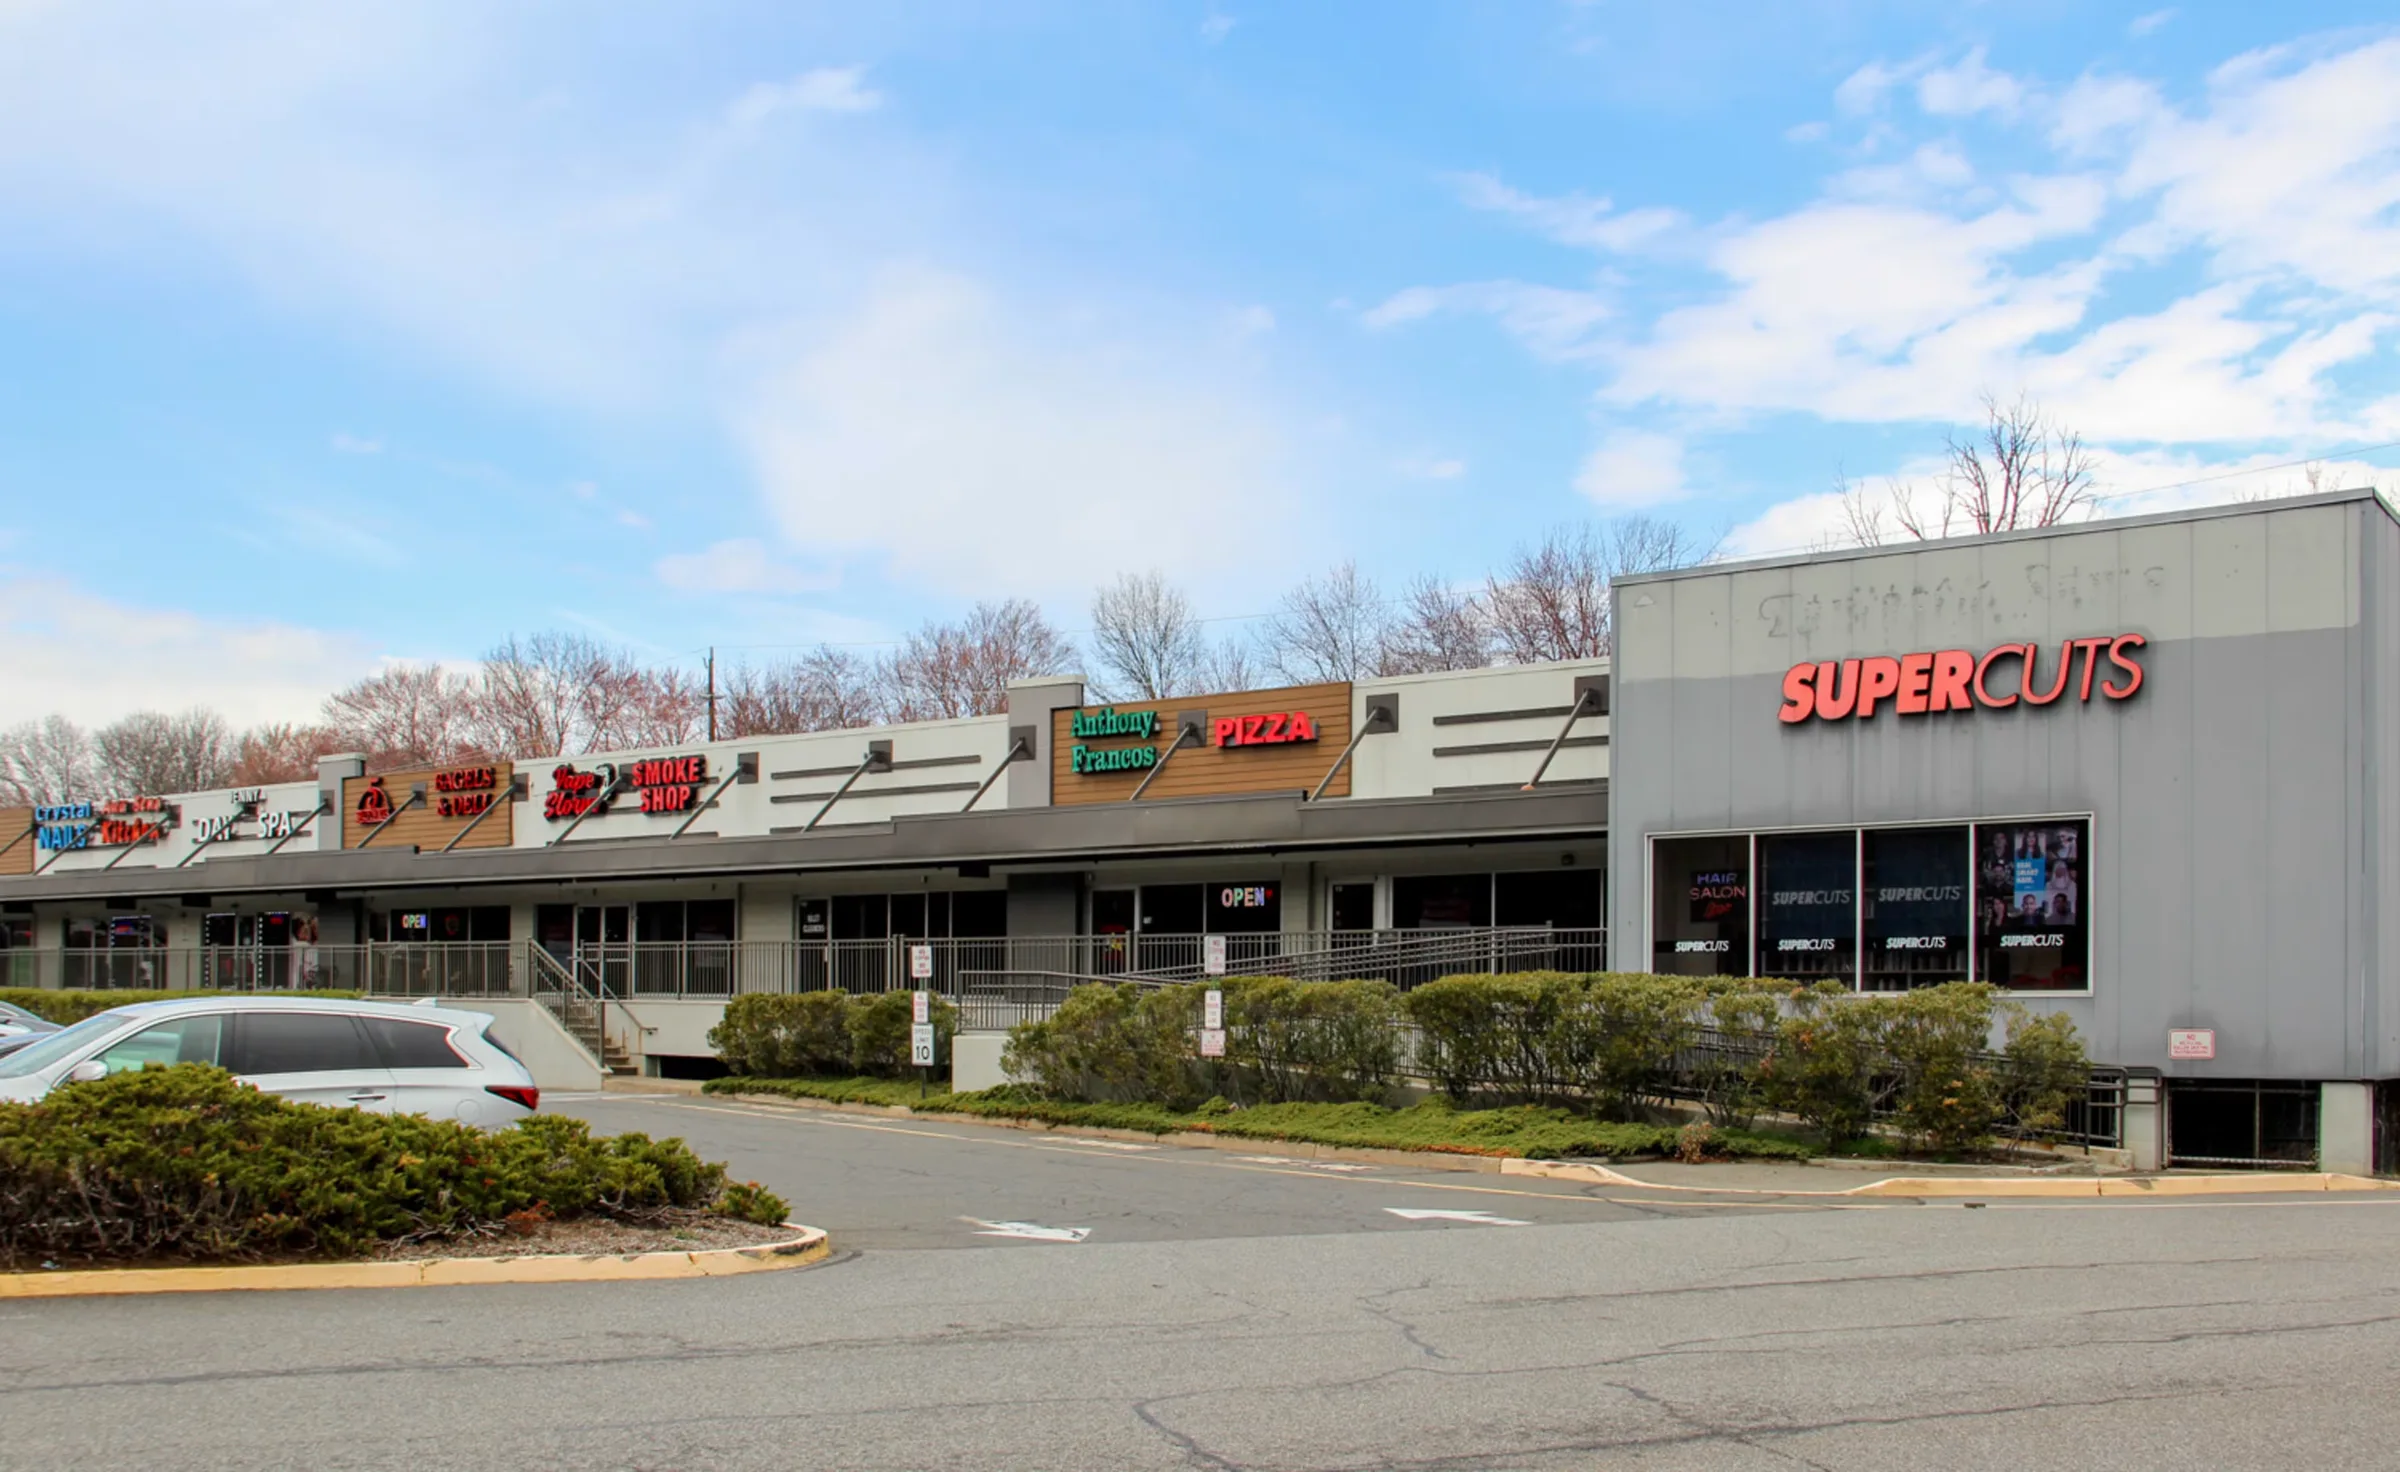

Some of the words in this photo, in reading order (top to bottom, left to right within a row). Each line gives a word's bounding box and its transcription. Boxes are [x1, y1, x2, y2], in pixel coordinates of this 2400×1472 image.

[1777, 633, 2146, 723] SUPERCUTS
[1070, 708, 1157, 739] Anthony
[1215, 712, 1315, 747] PIZZA
[1071, 746, 1156, 773] Francos
[434, 767, 494, 791] BAGELS
[554, 767, 595, 795] Vape
[632, 757, 700, 787] SMOKE
[640, 785, 692, 812] SHOP
[35, 800, 92, 821] Crystal
[199, 815, 234, 841] DAY
[257, 811, 291, 838] SPA
[38, 824, 88, 849] NAILS
[1697, 873, 1738, 885] HAIR
[1221, 887, 1265, 907] OPEN
[1689, 886, 1746, 900] SALON
[1773, 890, 1851, 905] SUPERCUTS
[1879, 886, 1961, 901] SUPERCUTS
[402, 914, 427, 929] OPEN
[1675, 940, 1730, 952] SUPERCUTS
[1778, 939, 1835, 951] SUPERCUTS
[1886, 936, 1946, 949] SUPERCUTS
[2000, 934, 2064, 947] SUPERCUTS
[916, 1046, 930, 1060] 10
